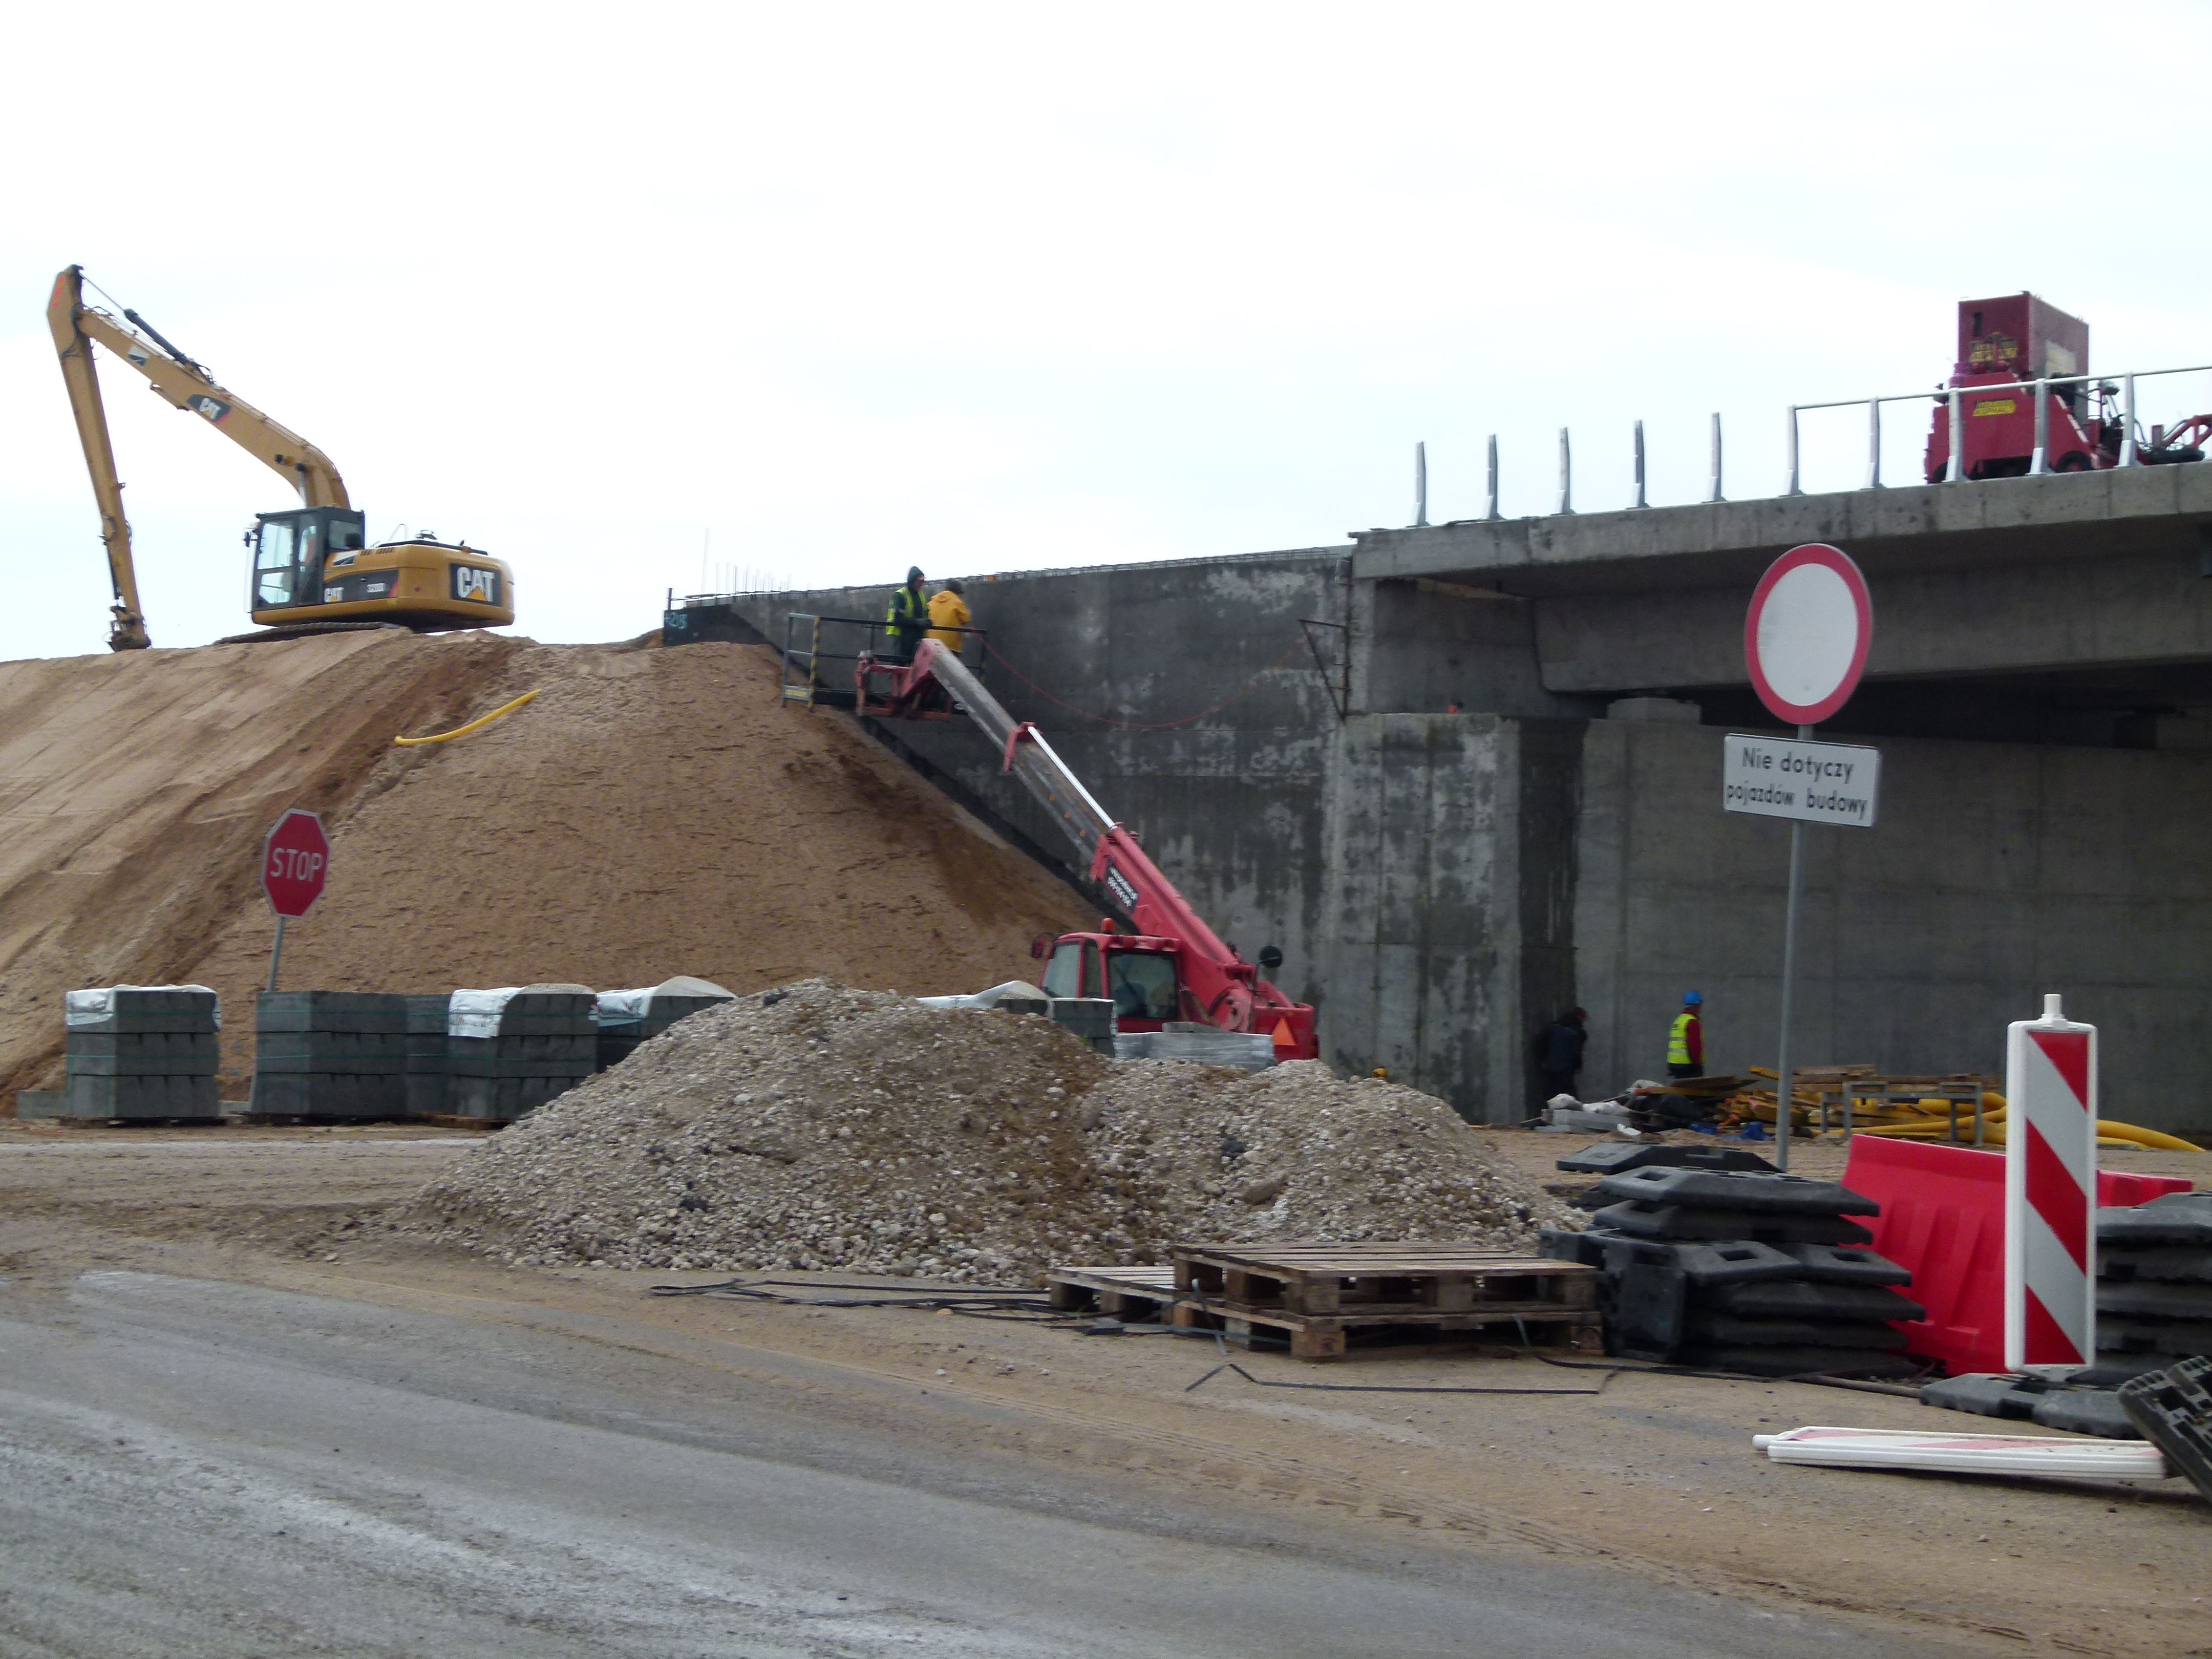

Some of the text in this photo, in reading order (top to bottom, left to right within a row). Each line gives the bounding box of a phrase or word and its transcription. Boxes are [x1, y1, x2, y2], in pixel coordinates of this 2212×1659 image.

[199, 398, 221, 419] CAT
[324, 587, 344, 603] CAT
[457, 567, 495, 602] CAT
[1742, 747, 1855, 784] Nie dotyczy
[1726, 780, 1868, 820] pojazdów budowy
[270, 847, 324, 882] STOP
